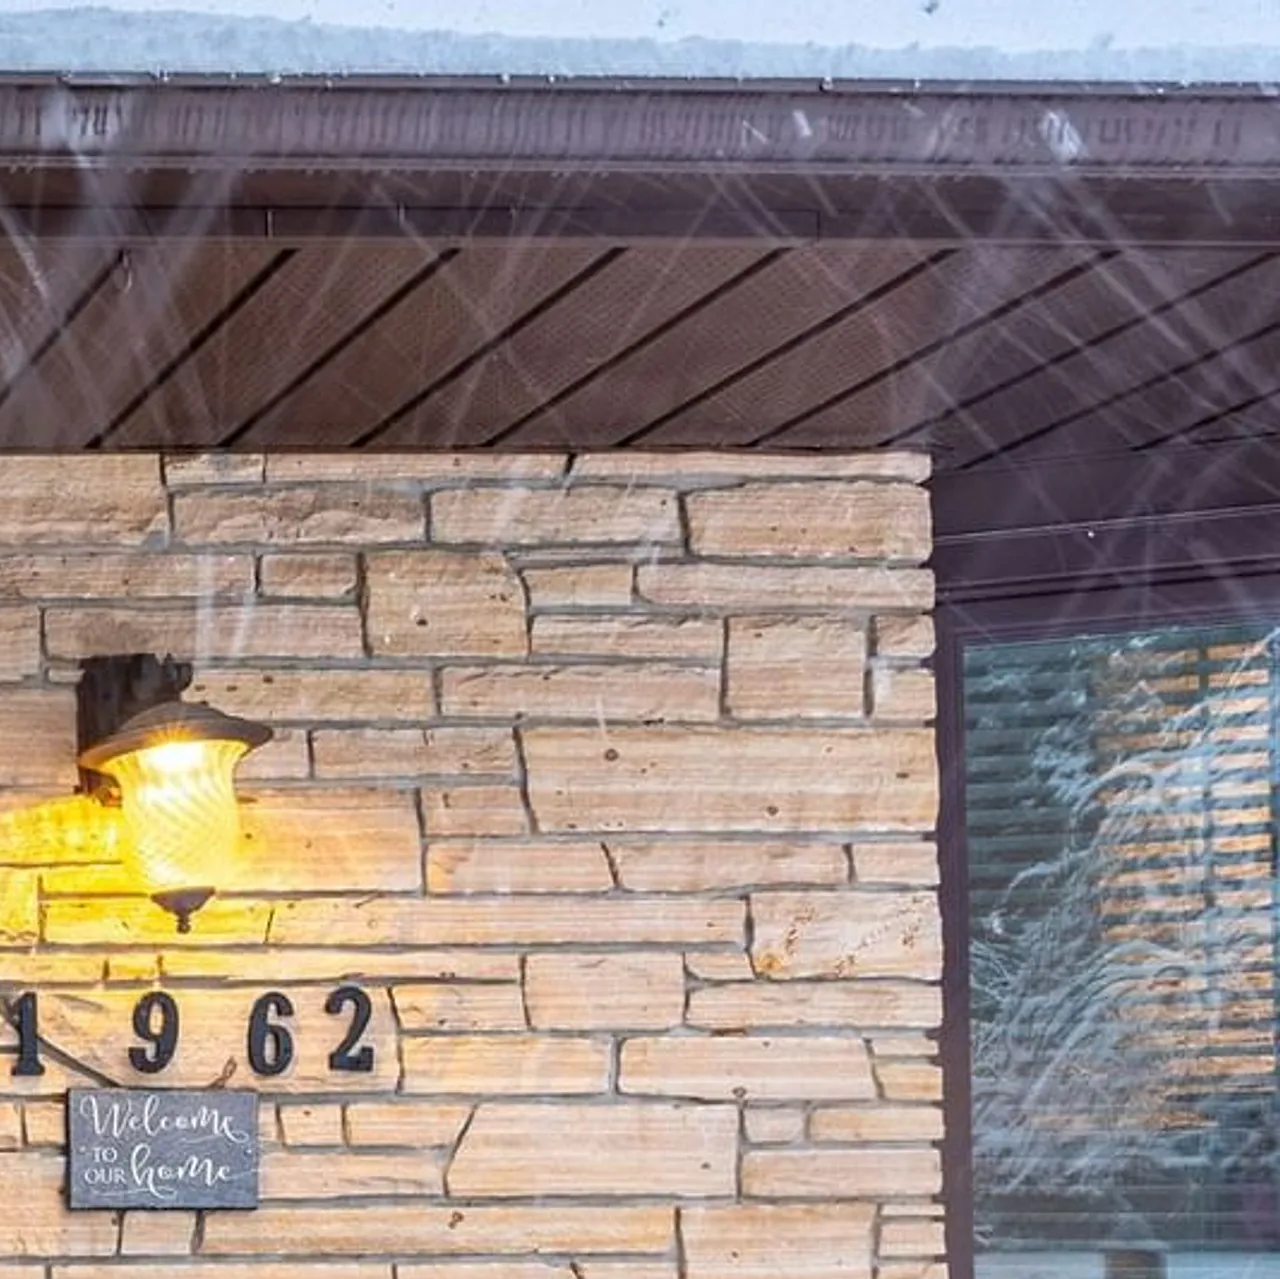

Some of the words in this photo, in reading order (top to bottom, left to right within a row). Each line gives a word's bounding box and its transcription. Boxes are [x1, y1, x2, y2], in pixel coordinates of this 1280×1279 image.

[79, 1094, 251, 1144] Welcome
[84, 1168, 126, 1186] OUR
[130, 1143, 232, 1198] home
[92, 1146, 119, 1164] TO
